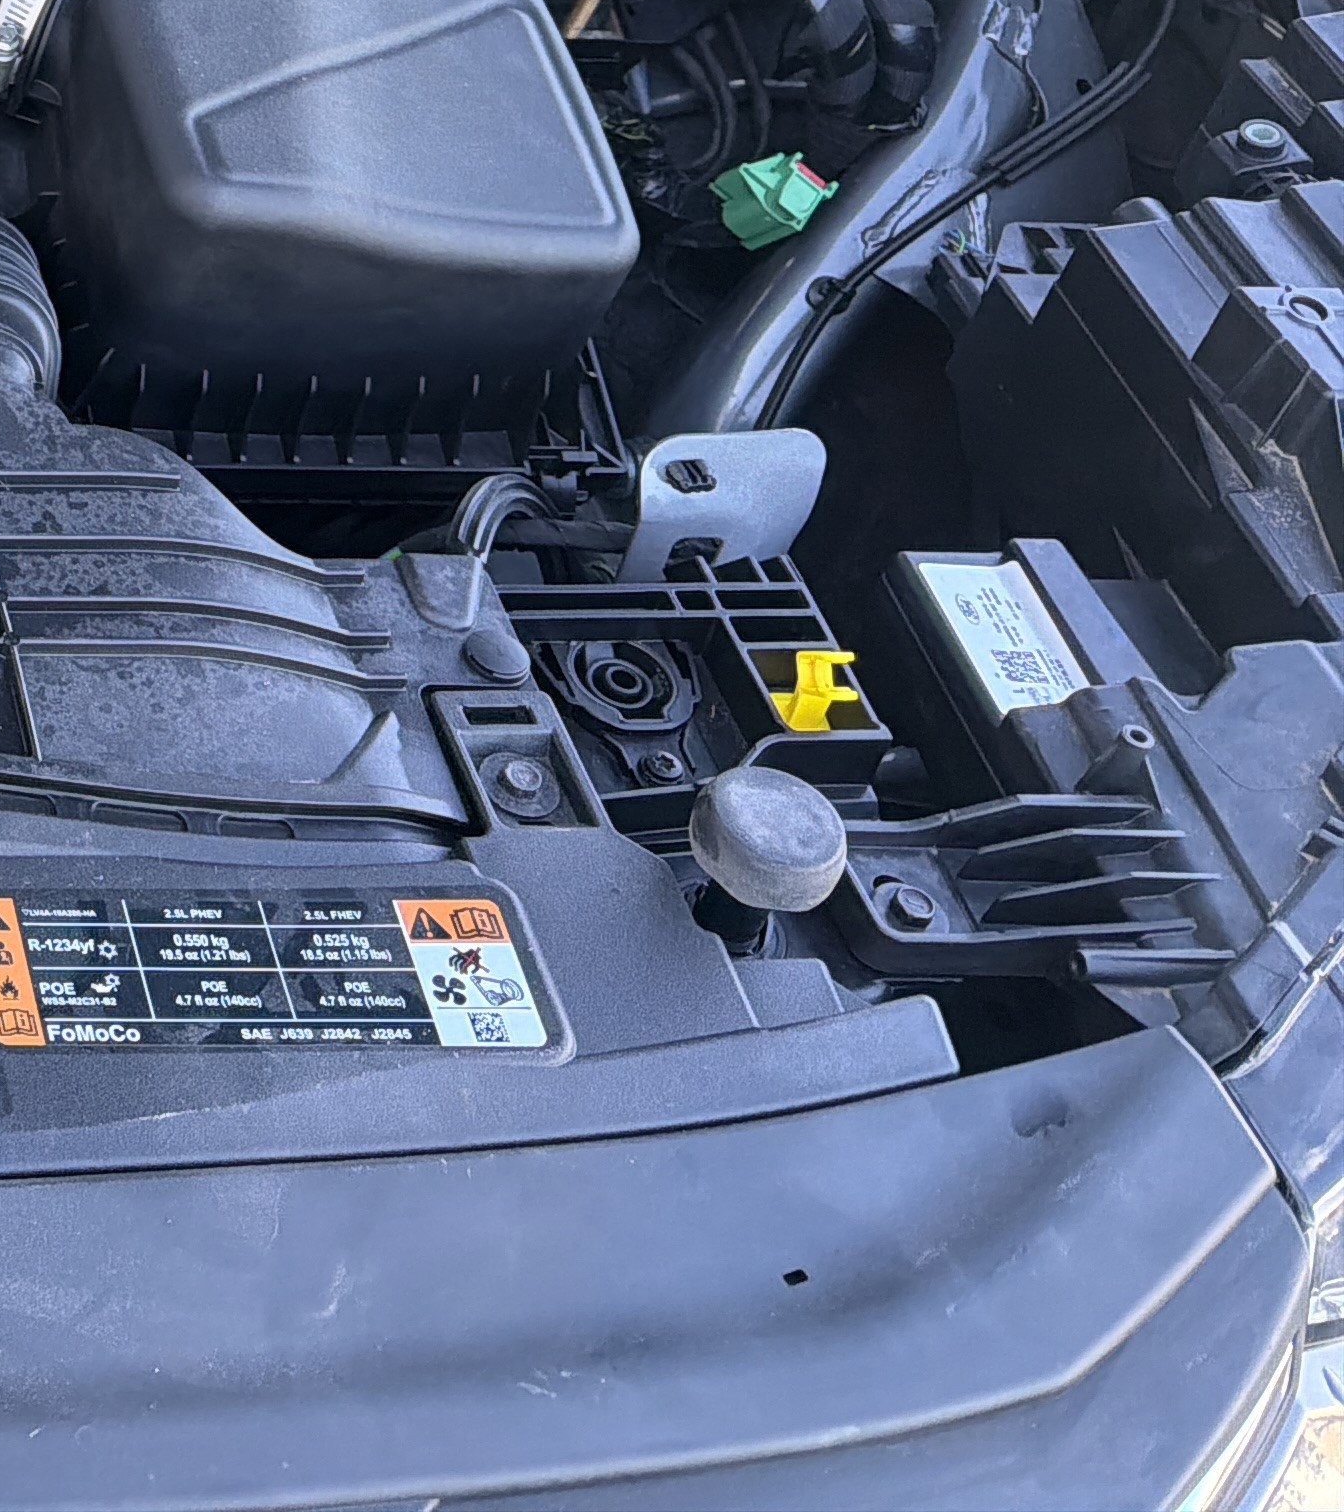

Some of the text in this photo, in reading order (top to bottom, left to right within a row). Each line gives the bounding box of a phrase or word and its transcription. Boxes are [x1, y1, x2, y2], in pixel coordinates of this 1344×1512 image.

[163, 909, 222, 919] 2.5L PHEV
[303, 910, 362, 920] 2.5L FHEV
[27, 938, 95, 954] R-1234yf
[172, 934, 230, 950] 0.550 kg
[312, 934, 370, 950] 0.525 kg
[185, 951, 200, 961] oz
[200, 949, 228, 963] (1.21
[228, 949, 251, 963] lbs)
[325, 951, 340, 961] oz
[340, 949, 369, 963] (1.15
[369, 949, 392, 963] lbs)
[39, 981, 77, 996] POE
[201, 981, 229, 993] POE
[343, 982, 372, 994] POE
[175, 995, 192, 1006] 4.7
[204, 997, 220, 1006] oz
[220, 995, 262, 1009] (140cc)
[319, 996, 335, 1006] 4.7
[348, 998, 363, 1006] oz
[363, 995, 406, 1009] (140cc)
[46, 1024, 141, 1042] FoMoCo
[240, 1028, 412, 1040] SAE J639 J2842 J2845
